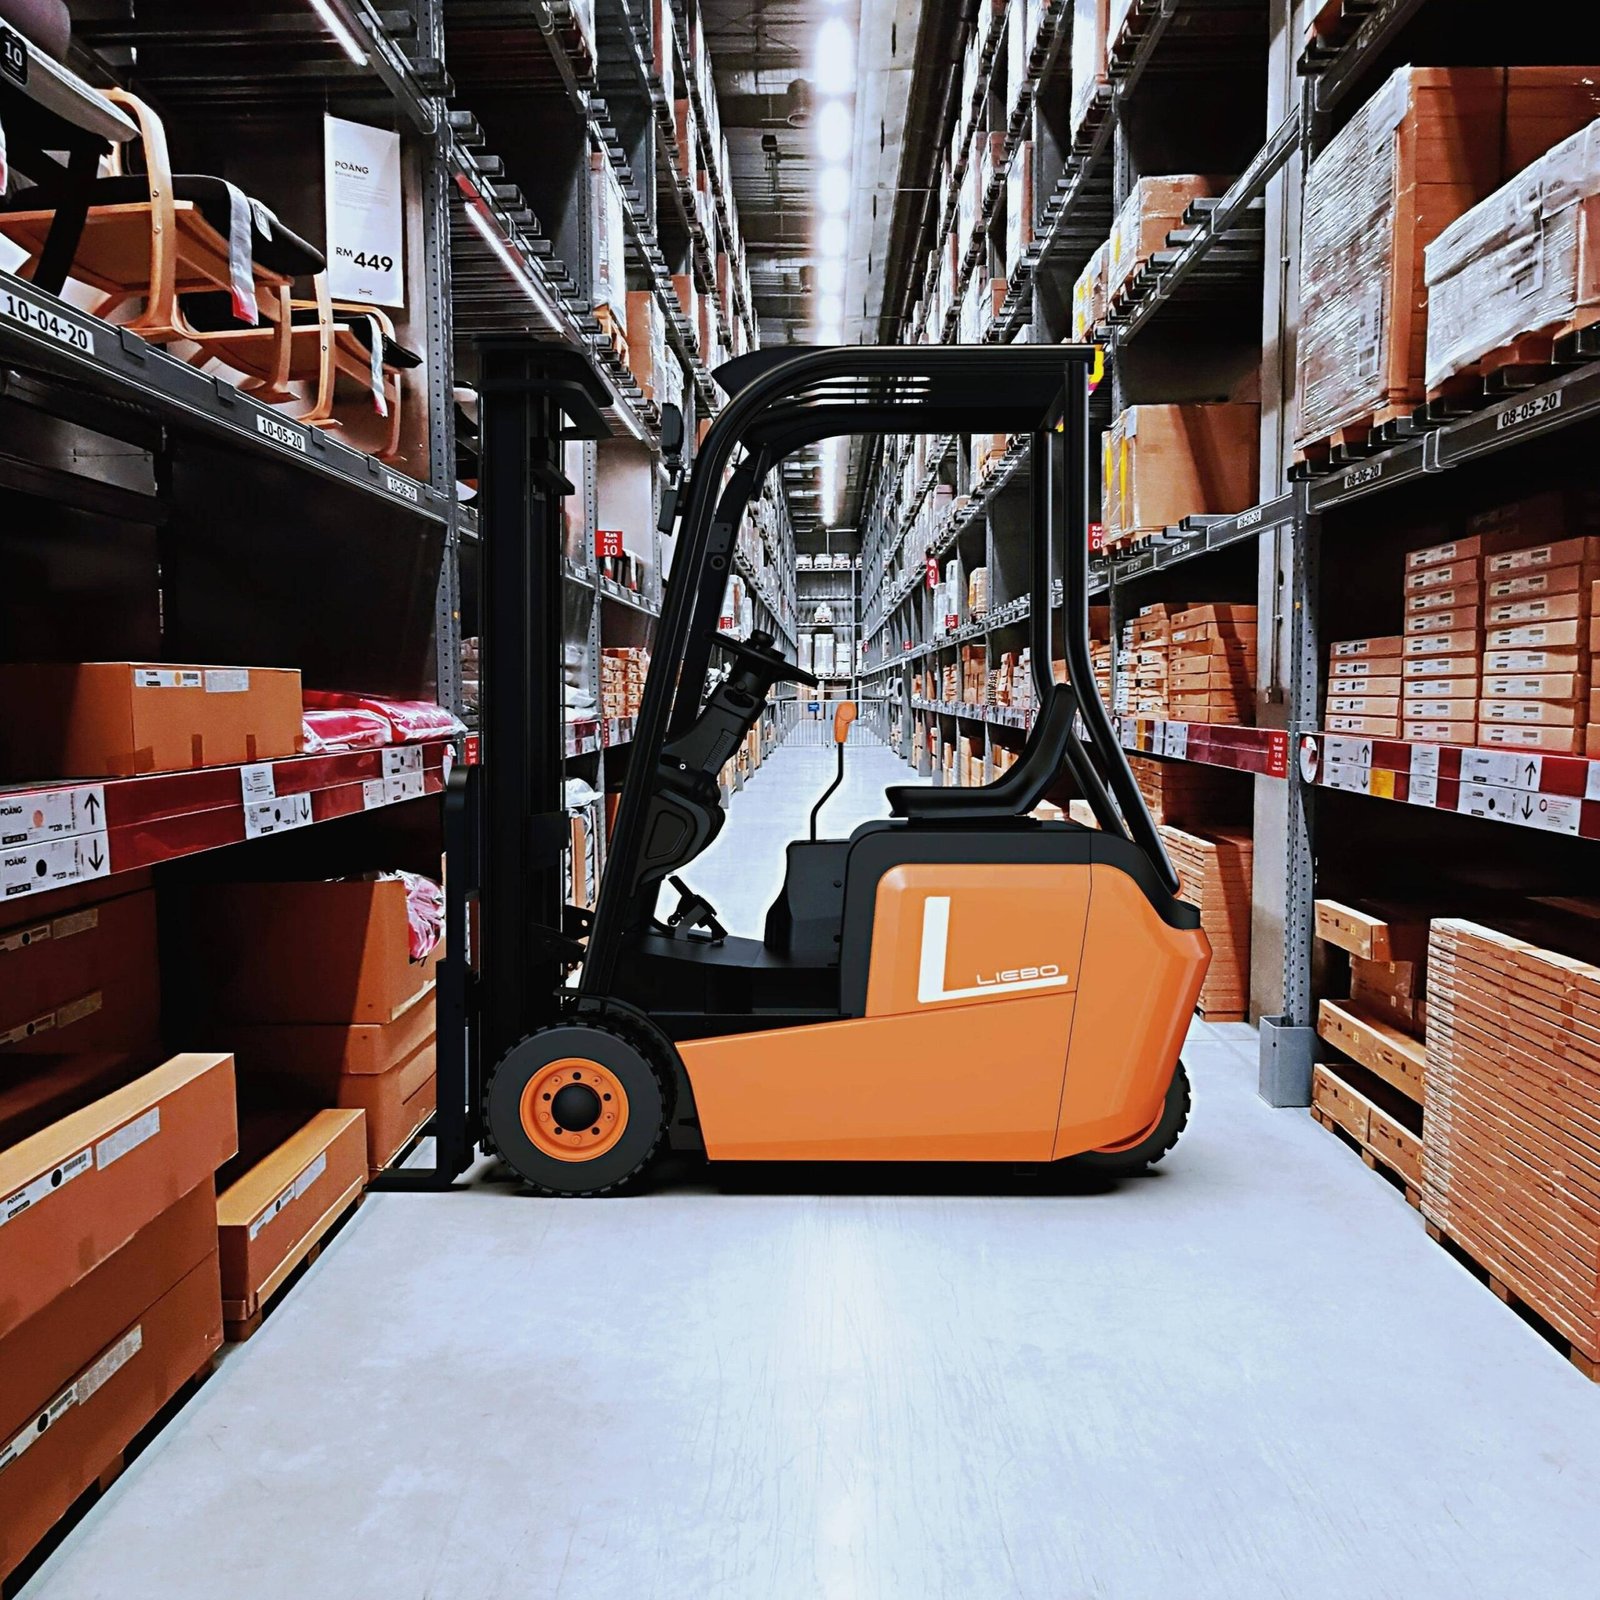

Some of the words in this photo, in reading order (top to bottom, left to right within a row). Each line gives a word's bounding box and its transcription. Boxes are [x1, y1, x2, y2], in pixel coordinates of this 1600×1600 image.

[5, 41, 23, 66] 10
[335, 247, 353, 258] RM
[353, 252, 393, 272] 449
[6, 295, 88, 350] 10-04-20
[1501, 392, 1558, 427] 08-05-20
[262, 419, 303, 449] 10-05-20
[603, 545, 618, 555] 10
[976, 964, 1059, 985] LIEBO
